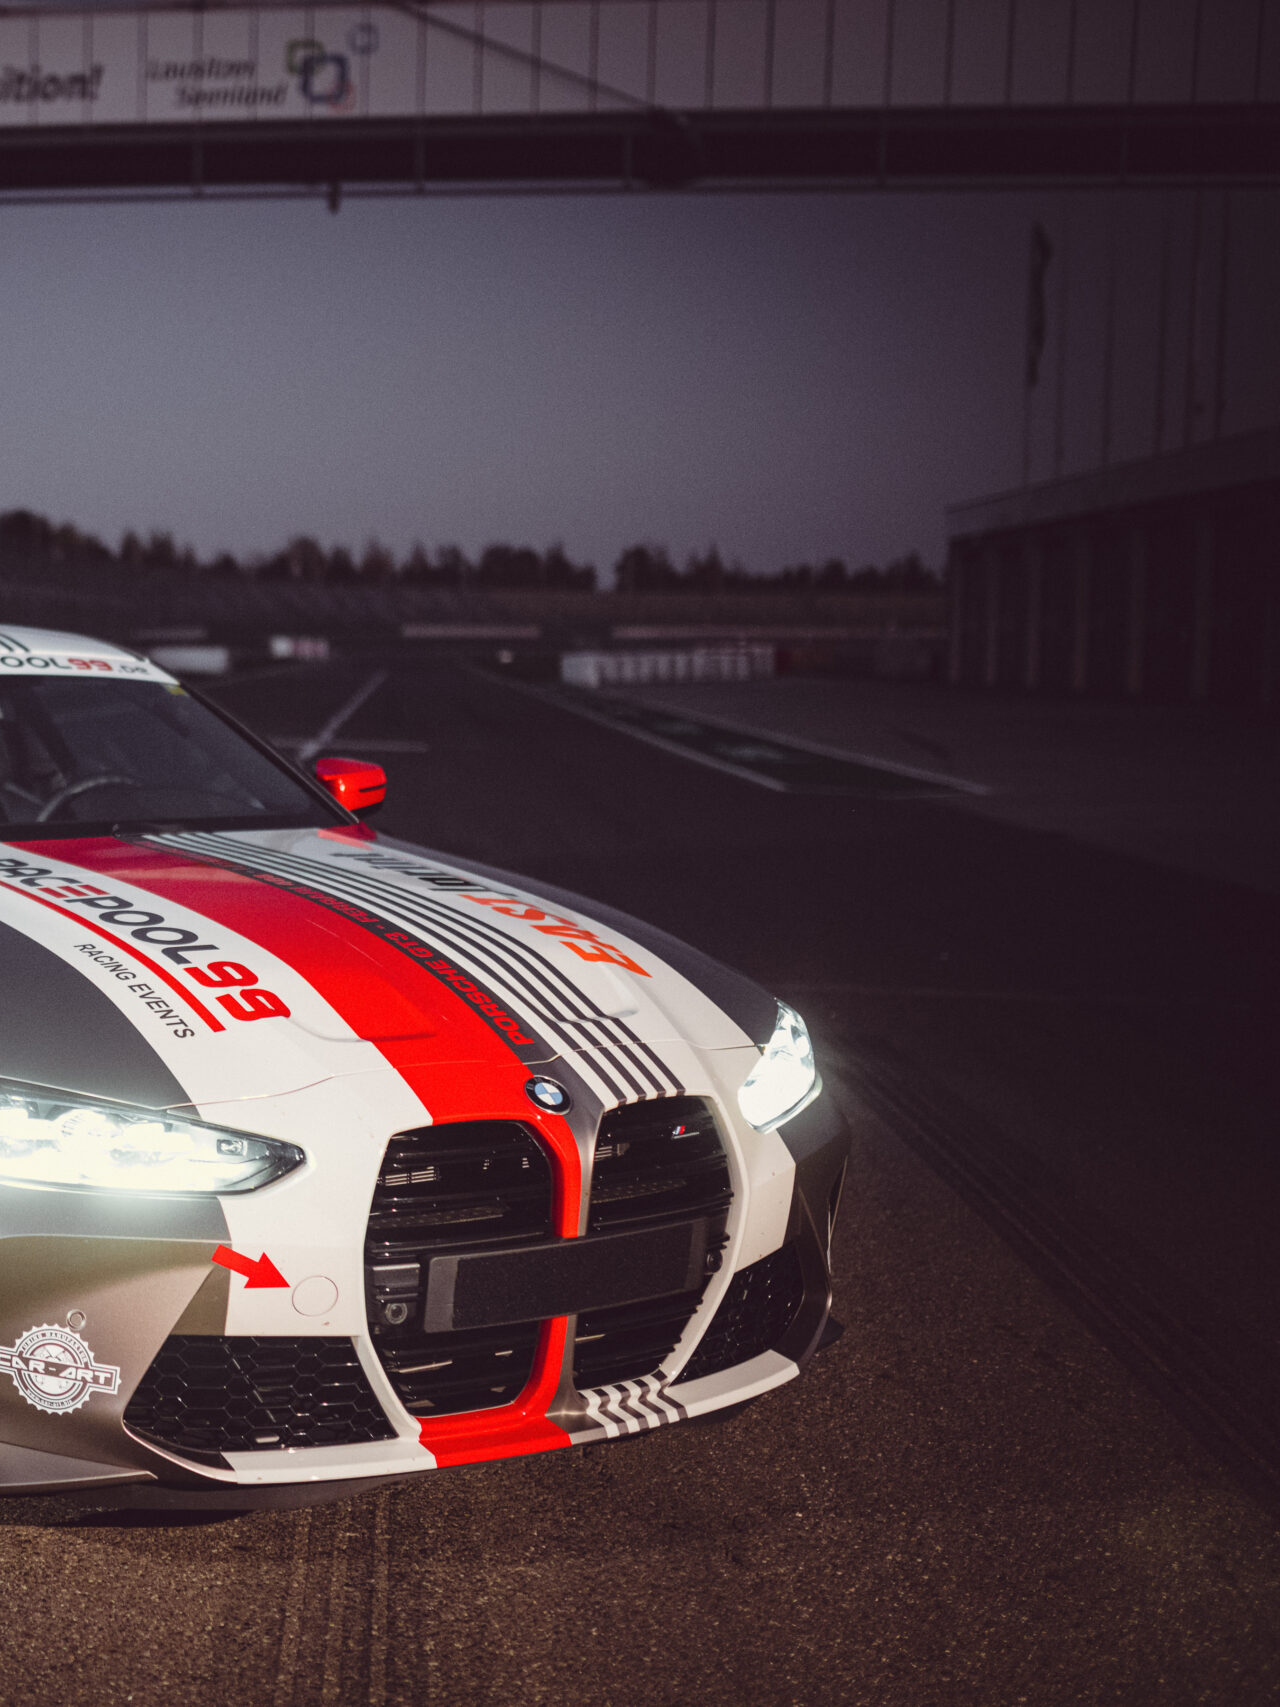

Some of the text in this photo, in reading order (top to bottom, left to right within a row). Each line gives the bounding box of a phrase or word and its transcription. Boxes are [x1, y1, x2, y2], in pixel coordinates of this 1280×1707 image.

[384, 931, 433, 958] GT3
[73, 943, 195, 1039] RACING EVENTS
[425, 959, 535, 1045] PORSCHE
